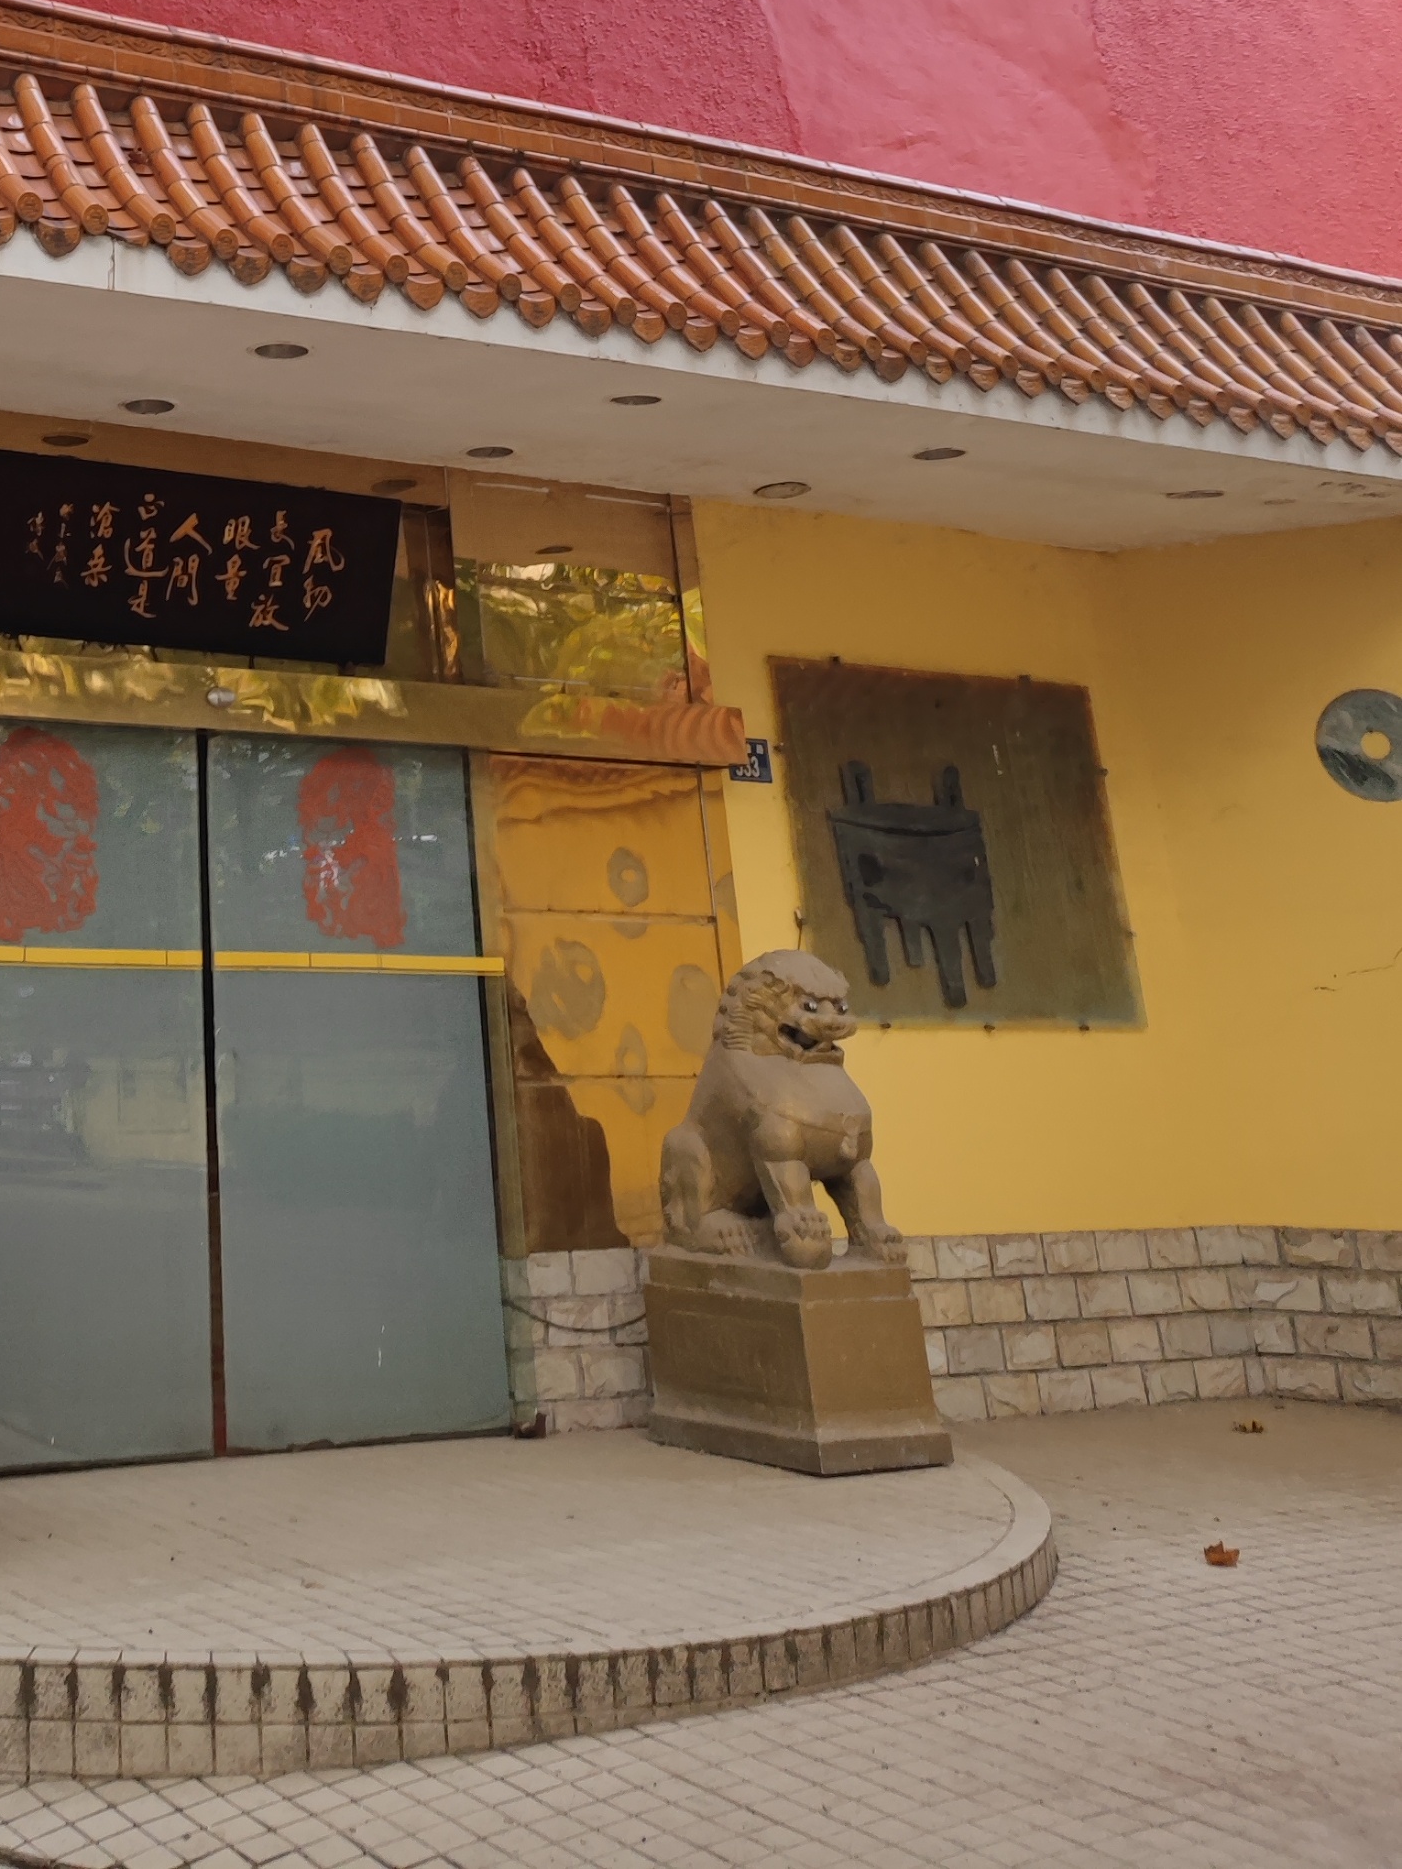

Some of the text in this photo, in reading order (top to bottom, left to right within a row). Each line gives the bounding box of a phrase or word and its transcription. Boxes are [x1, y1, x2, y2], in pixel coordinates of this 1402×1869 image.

[124, 492, 169, 619] 正道是
[214, 515, 261, 601] 眼量
